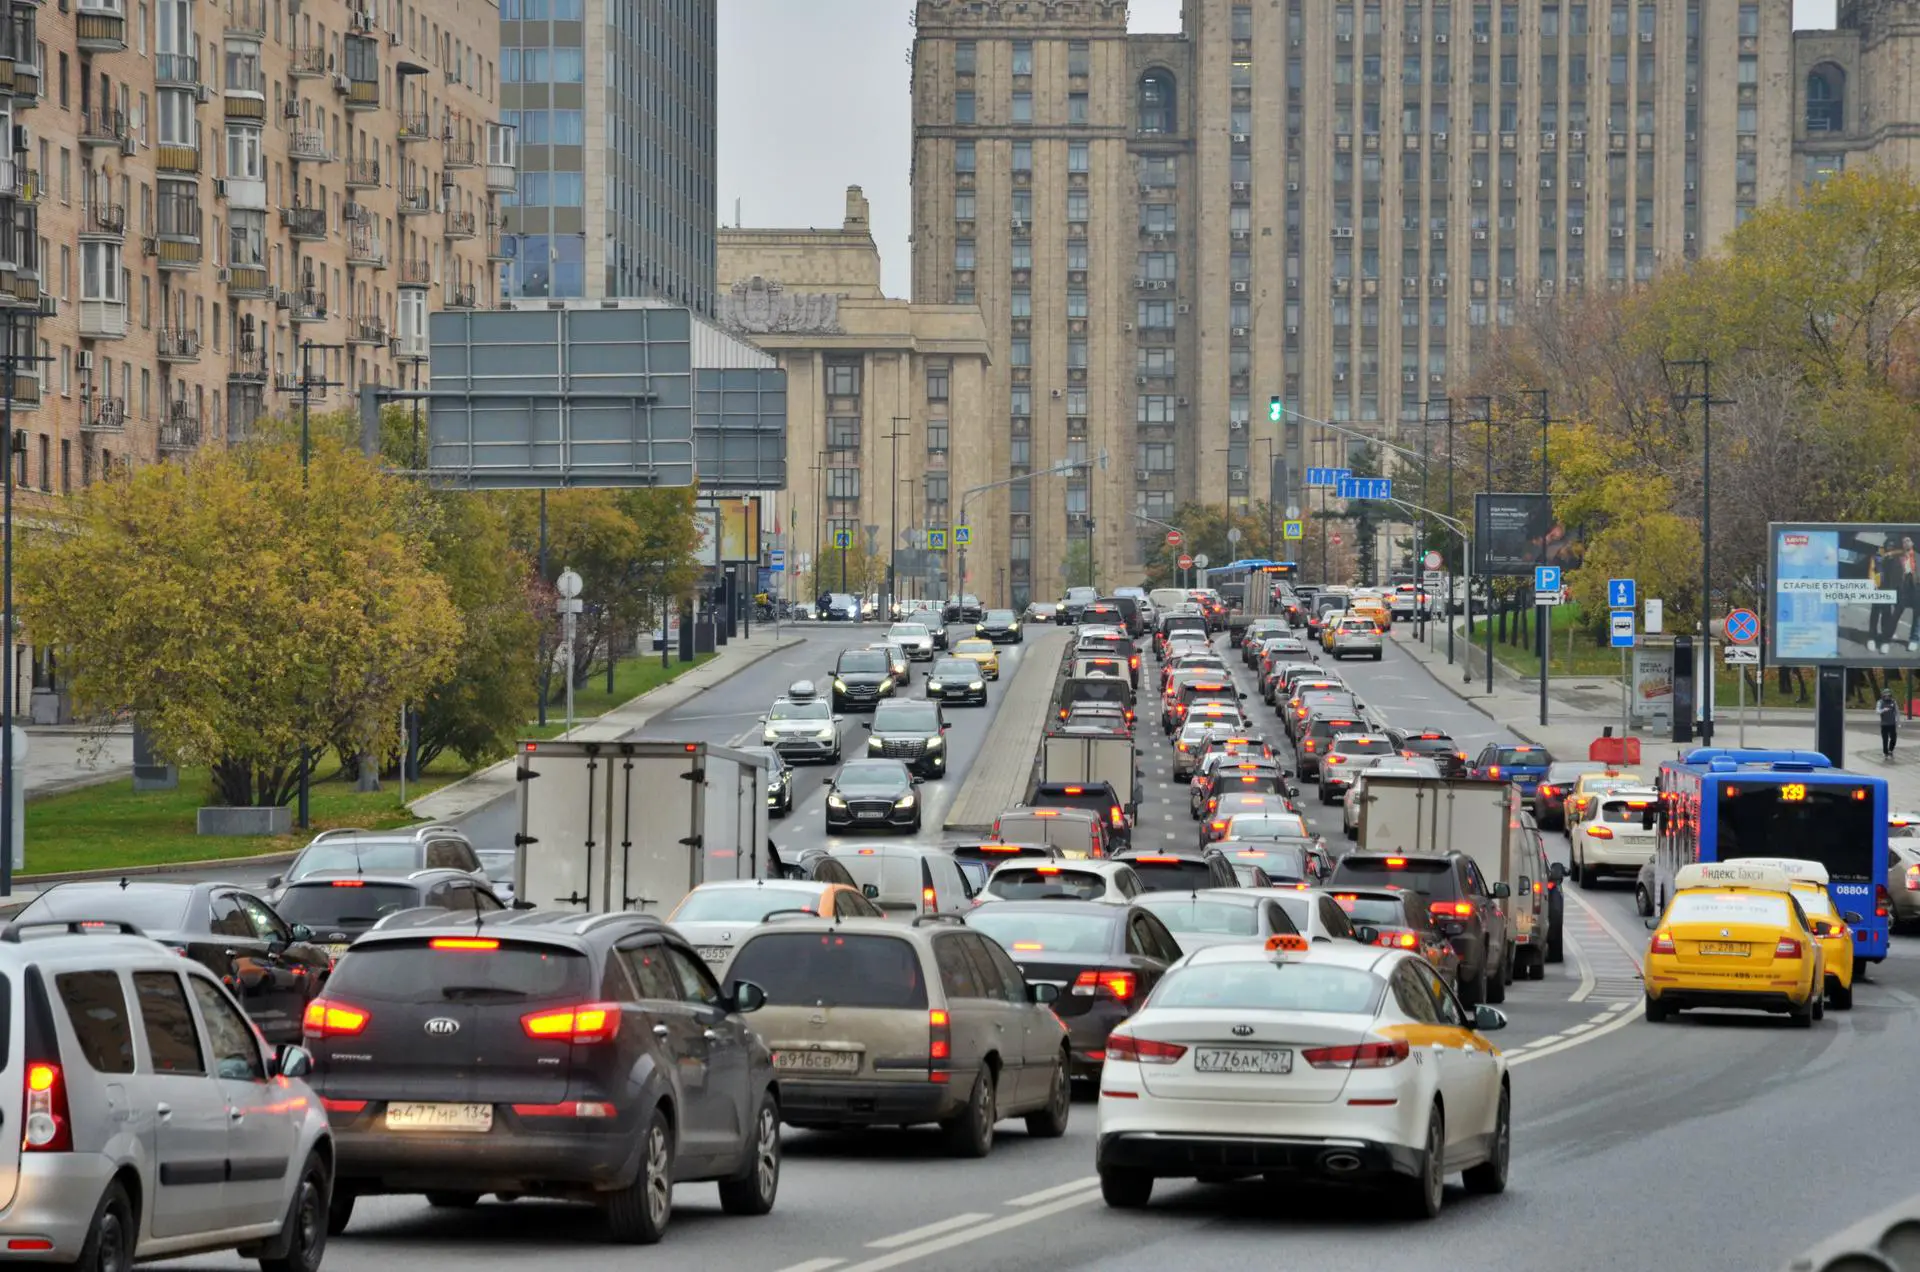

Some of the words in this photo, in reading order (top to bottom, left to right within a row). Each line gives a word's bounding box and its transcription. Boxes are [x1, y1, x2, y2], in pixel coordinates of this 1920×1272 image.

[1542, 569, 1556, 588] P
[1783, 582, 1820, 590] СТАРЫЕ
[1822, 581, 1869, 590] БУТЫЛКИ.
[1825, 593, 1856, 601] НОВАЯ
[1858, 592, 1895, 601] ЖИЗНЬ.
[1702, 866, 1735, 880] Яндекс
[1738, 867, 1764, 879] Такси
[1836, 885, 1869, 895] 08804
[1200, 1051, 1259, 1067] К776АК
[1264, 1051, 1286, 1064] 797
